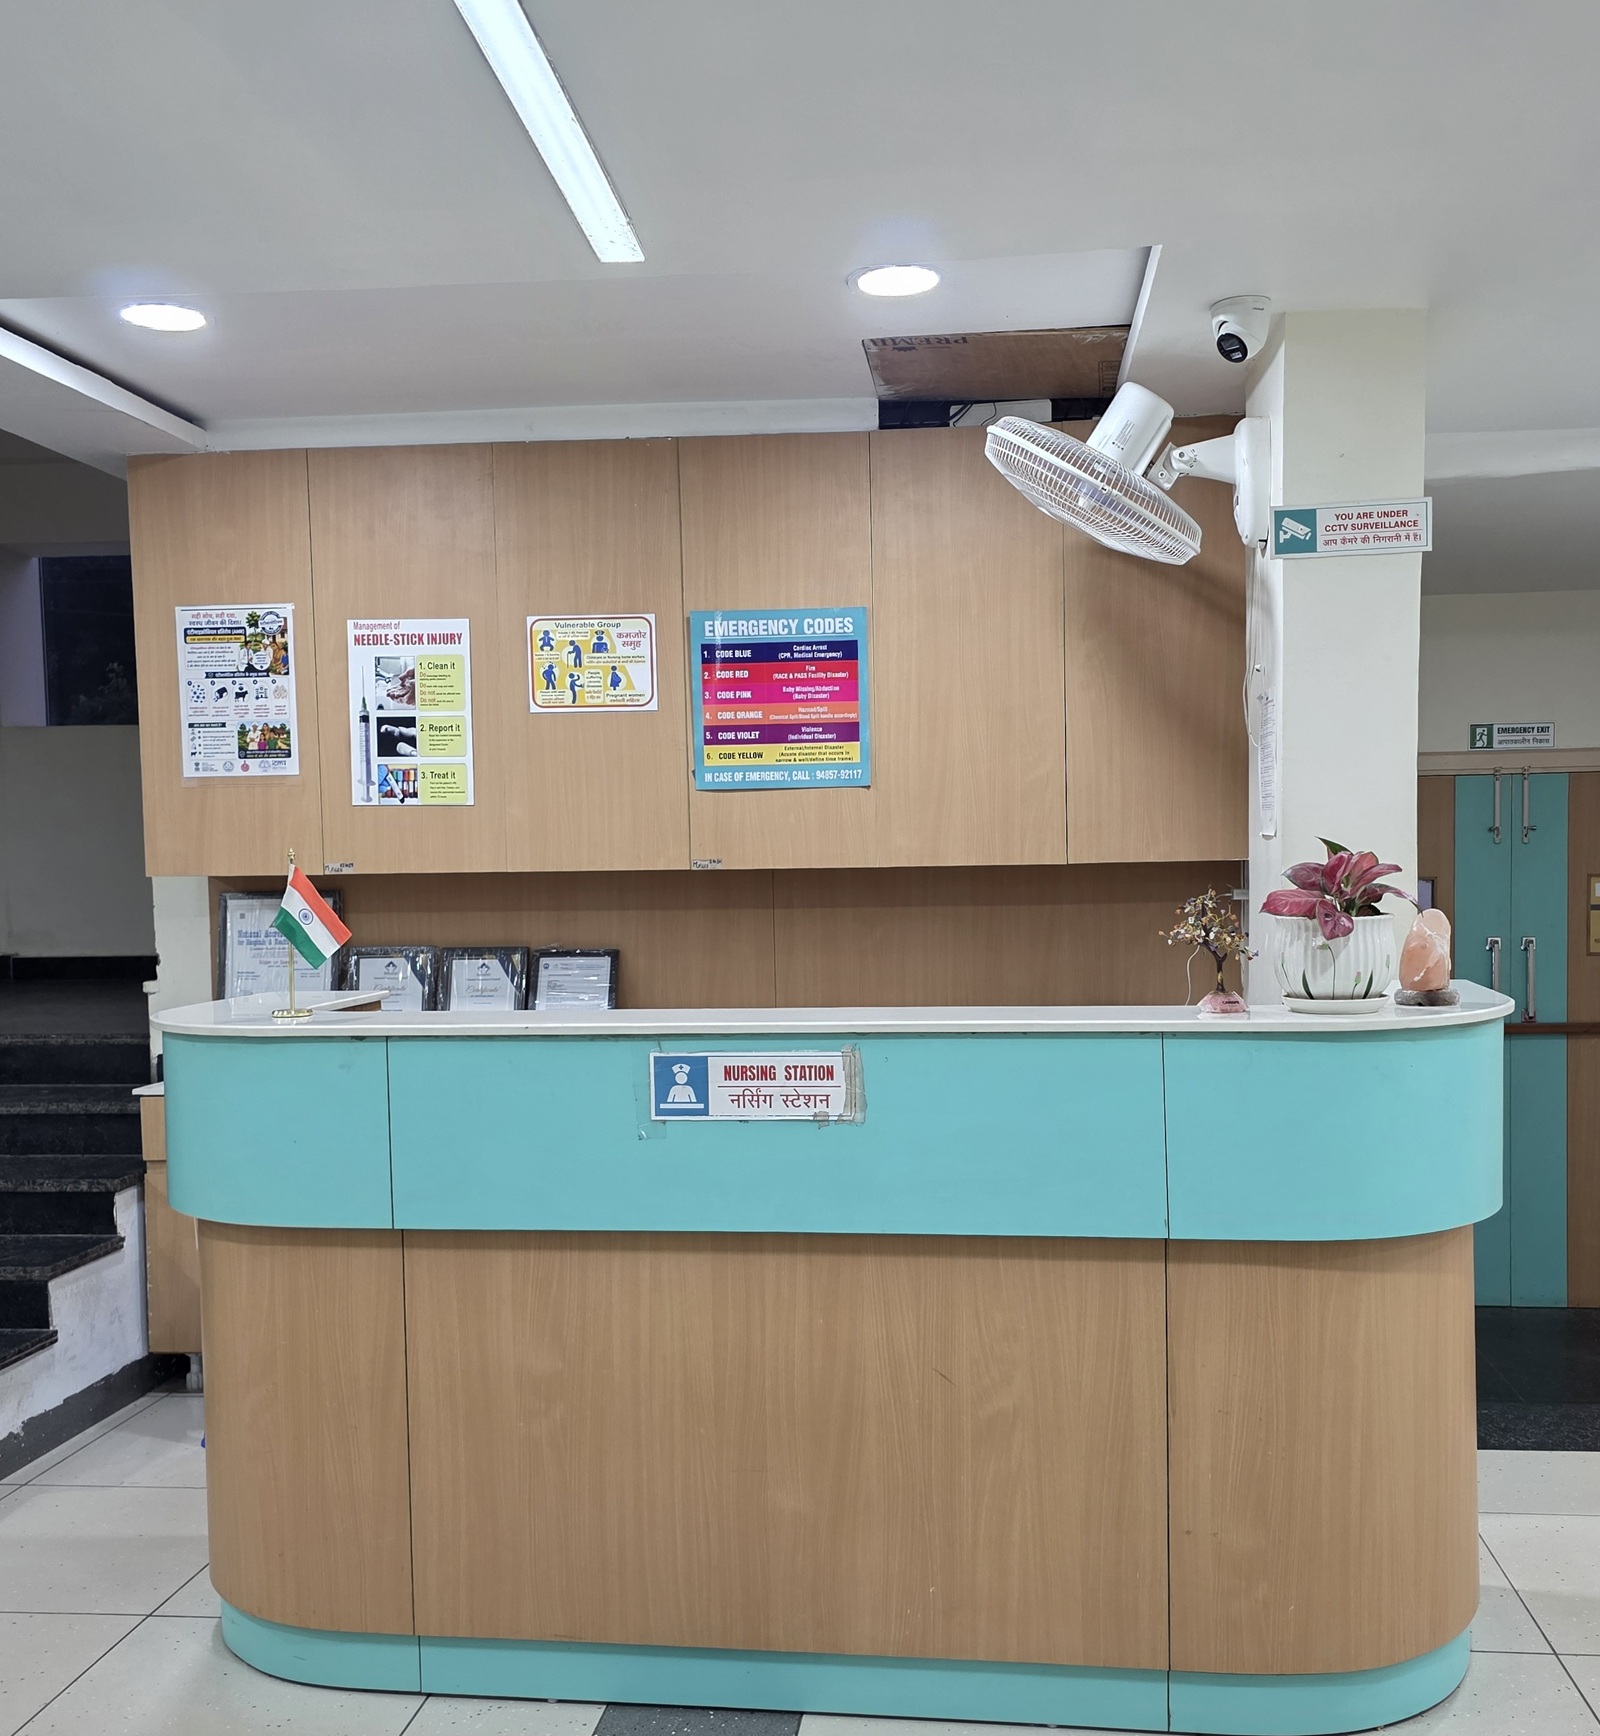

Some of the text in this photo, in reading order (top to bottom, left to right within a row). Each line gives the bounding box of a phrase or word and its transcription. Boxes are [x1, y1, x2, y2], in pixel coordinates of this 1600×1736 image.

[1334, 512, 1354, 520] YOU
[1377, 510, 1408, 518] UNDER
[1324, 520, 1418, 532] CCTV SURVEILLANCE
[1360, 534, 1370, 544] की
[1372, 532, 1401, 543] निगरानी
[353, 621, 400, 632] Management of
[704, 617, 854, 637] EMERGENCY CODES
[354, 632, 463, 646] NEEDLE-STICK INJURY
[616, 630, 646, 639] कमजोर
[428, 724, 453, 733] Report
[421, 771, 428, 779] 3.
[430, 771, 449, 779] Treat
[704, 773, 712, 782] IN
[714, 772, 732, 782] CASE
[734, 772, 743, 782] OF
[746, 771, 790, 782] EMERGENCY,
[792, 771, 810, 780] CALL
[724, 1065, 834, 1081] NURSING STATION
[728, 1088, 831, 1108] नर्सिंग स्टेशन
